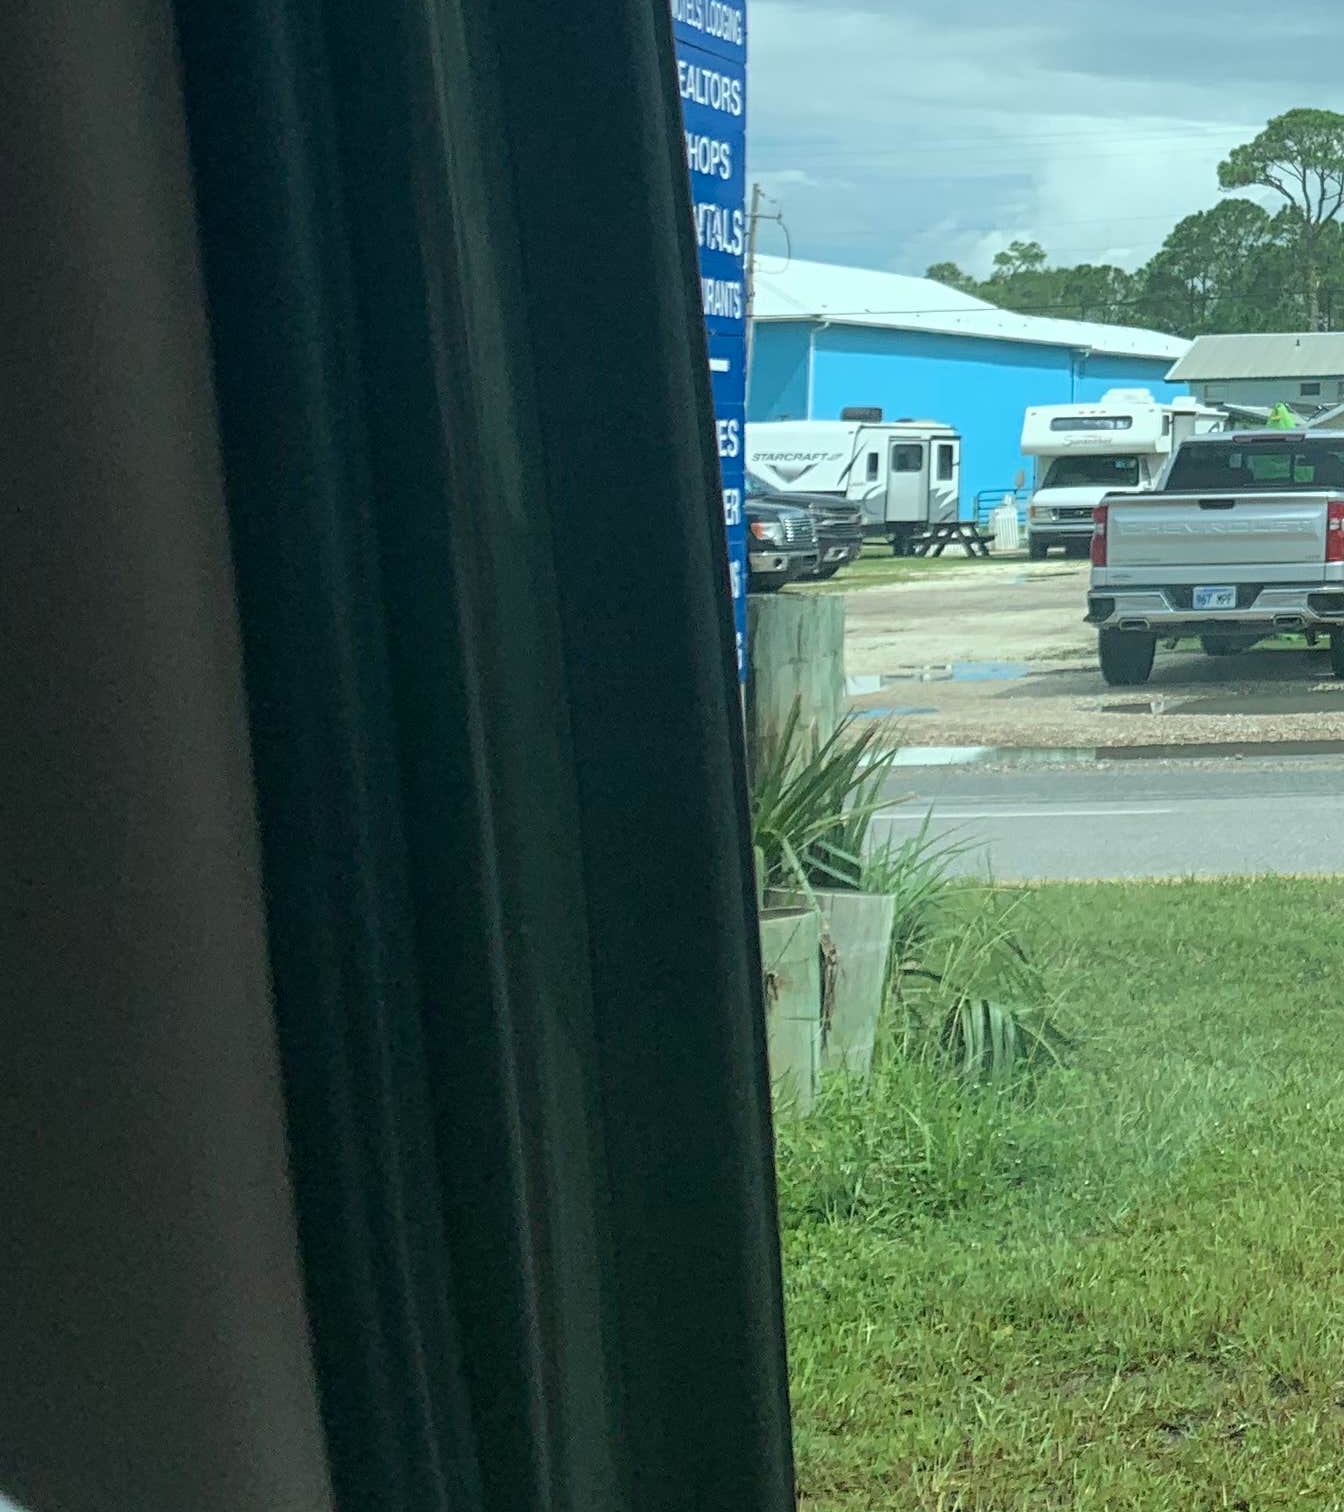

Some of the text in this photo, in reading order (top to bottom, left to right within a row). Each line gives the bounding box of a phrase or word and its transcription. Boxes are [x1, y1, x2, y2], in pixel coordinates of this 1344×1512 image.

[677, 60, 742, 117] EALTORS
[684, 129, 731, 180] HOPS
[752, 453, 828, 462] STARCRAFT
